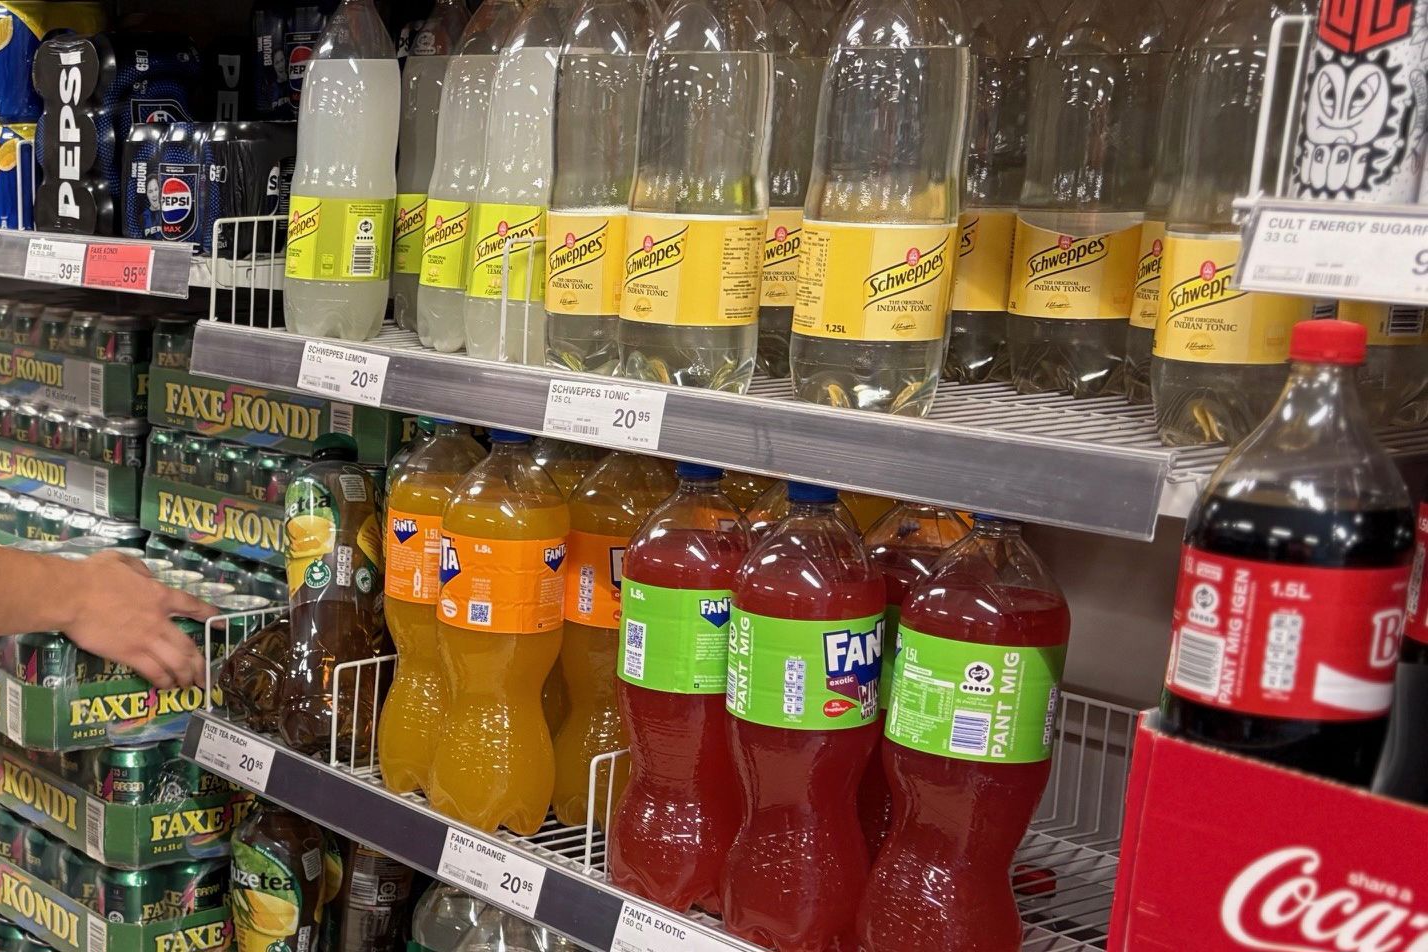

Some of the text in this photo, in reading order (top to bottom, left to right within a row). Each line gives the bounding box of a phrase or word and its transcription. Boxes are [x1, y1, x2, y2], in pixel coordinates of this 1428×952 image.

[58, 50, 82, 219] PEPSI
[137, 162, 148, 194] BRUUN
[1268, 217, 1305, 230] CULT
[1309, 219, 1367, 233] ENERGY
[476, 225, 535, 262] Schweppes
[1263, 232, 1299, 243] 33 CL
[91, 246, 102, 254] FAXE
[549, 236, 603, 274] Schweppes
[625, 240, 681, 279] Schweppes
[1028, 236, 1105, 278] Schweppes
[59, 263, 72, 279] 39
[122, 266, 137, 283] 95
[868, 250, 943, 298] Schweppes
[552, 281, 593, 290] INDIAN TONIC
[627, 287, 669, 297] INDIAN TONIC
[1033, 284, 1061, 292] INDIAN
[876, 304, 908, 312] INDIAN
[825, 324, 847, 333] 1,25L
[1174, 320, 1238, 332] INDIAN TONIC
[307, 345, 368, 364] SCHWEPPES LEMON
[15, 355, 63, 389] KONDI
[350, 369, 379, 388] 20 95
[551, 384, 630, 401] SCHWEPPES TONIC
[563, 396, 572, 404] CL
[165, 381, 321, 442] FAXE KONDI
[612, 408, 650, 429] 20 95
[15, 453, 67, 488] KONDI
[158, 491, 218, 534] FAXE
[393, 517, 418, 533] FANTA
[424, 528, 440, 540] 1.5L
[474, 544, 493, 554] 1.5L
[1270, 580, 1312, 600] 1.5L
[700, 597, 730, 615] FAN
[1218, 569, 1251, 704] PANT MIG IGEN
[736, 616, 750, 715] PANT MIG
[829, 676, 854, 687] exotic
[70, 690, 150, 726] FAXE
[991, 652, 1020, 758] PANT MIG
[204, 723, 248, 747] FUZE TEA PEACH
[239, 754, 264, 772] 20 95
[3, 760, 78, 831] KONDI
[151, 806, 225, 842] FAXE
[450, 832, 507, 863] FANTA ORANGE
[500, 871, 534, 894] 20 95
[1347, 871, 1413, 902] share a
[2, 872, 79, 948] KONDI
[622, 916, 644, 932] 150 CL
[623, 905, 687, 941] FANTA EXOTIC
[155, 921, 225, 952] FAXE
